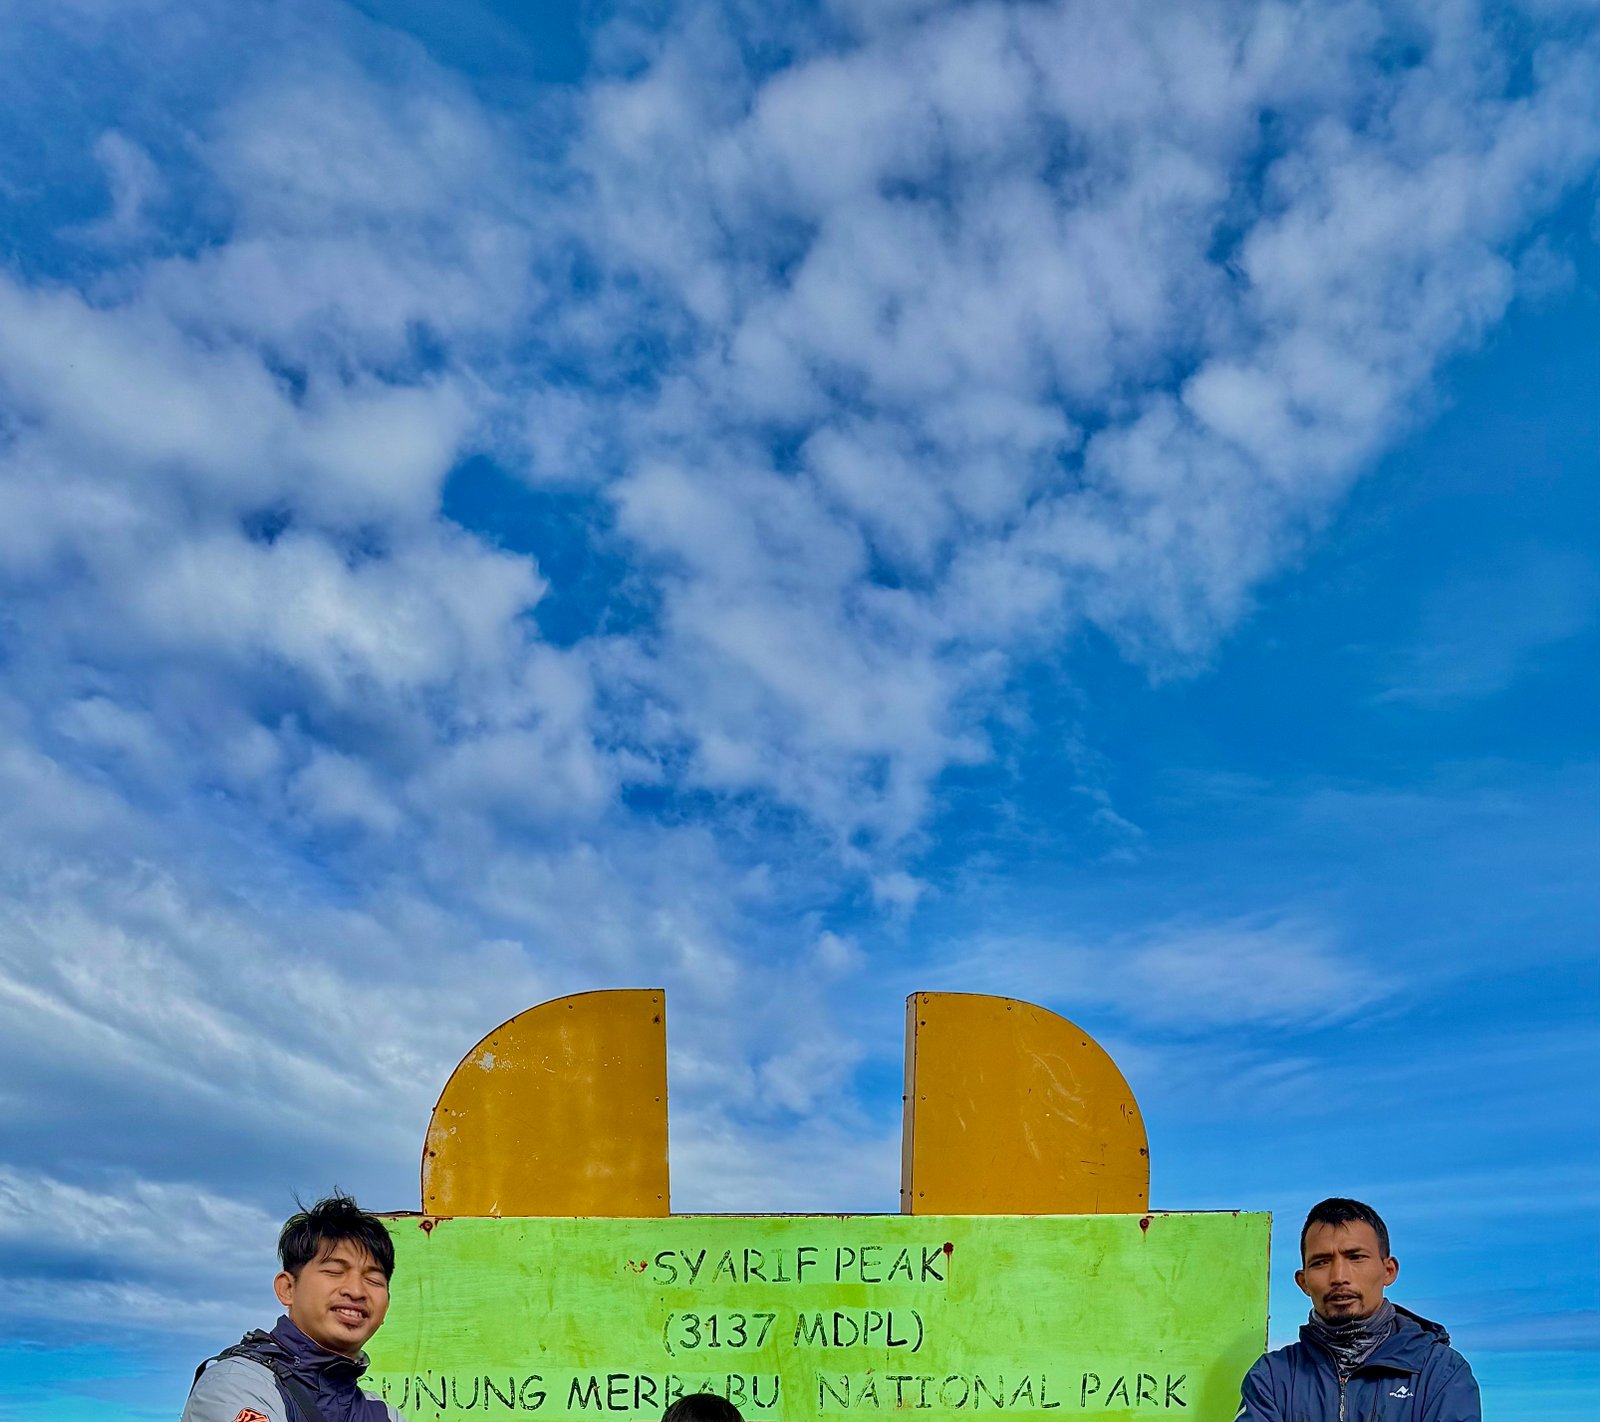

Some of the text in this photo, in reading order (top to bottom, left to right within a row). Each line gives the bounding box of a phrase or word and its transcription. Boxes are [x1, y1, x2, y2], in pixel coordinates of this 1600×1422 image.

[652, 1245, 945, 1286] SYARIF PEAK
[662, 1309, 924, 1357] (3137 MDPL)
[817, 1373, 1061, 1410] NATIONAL
[1081, 1372, 1188, 1408] PARK
